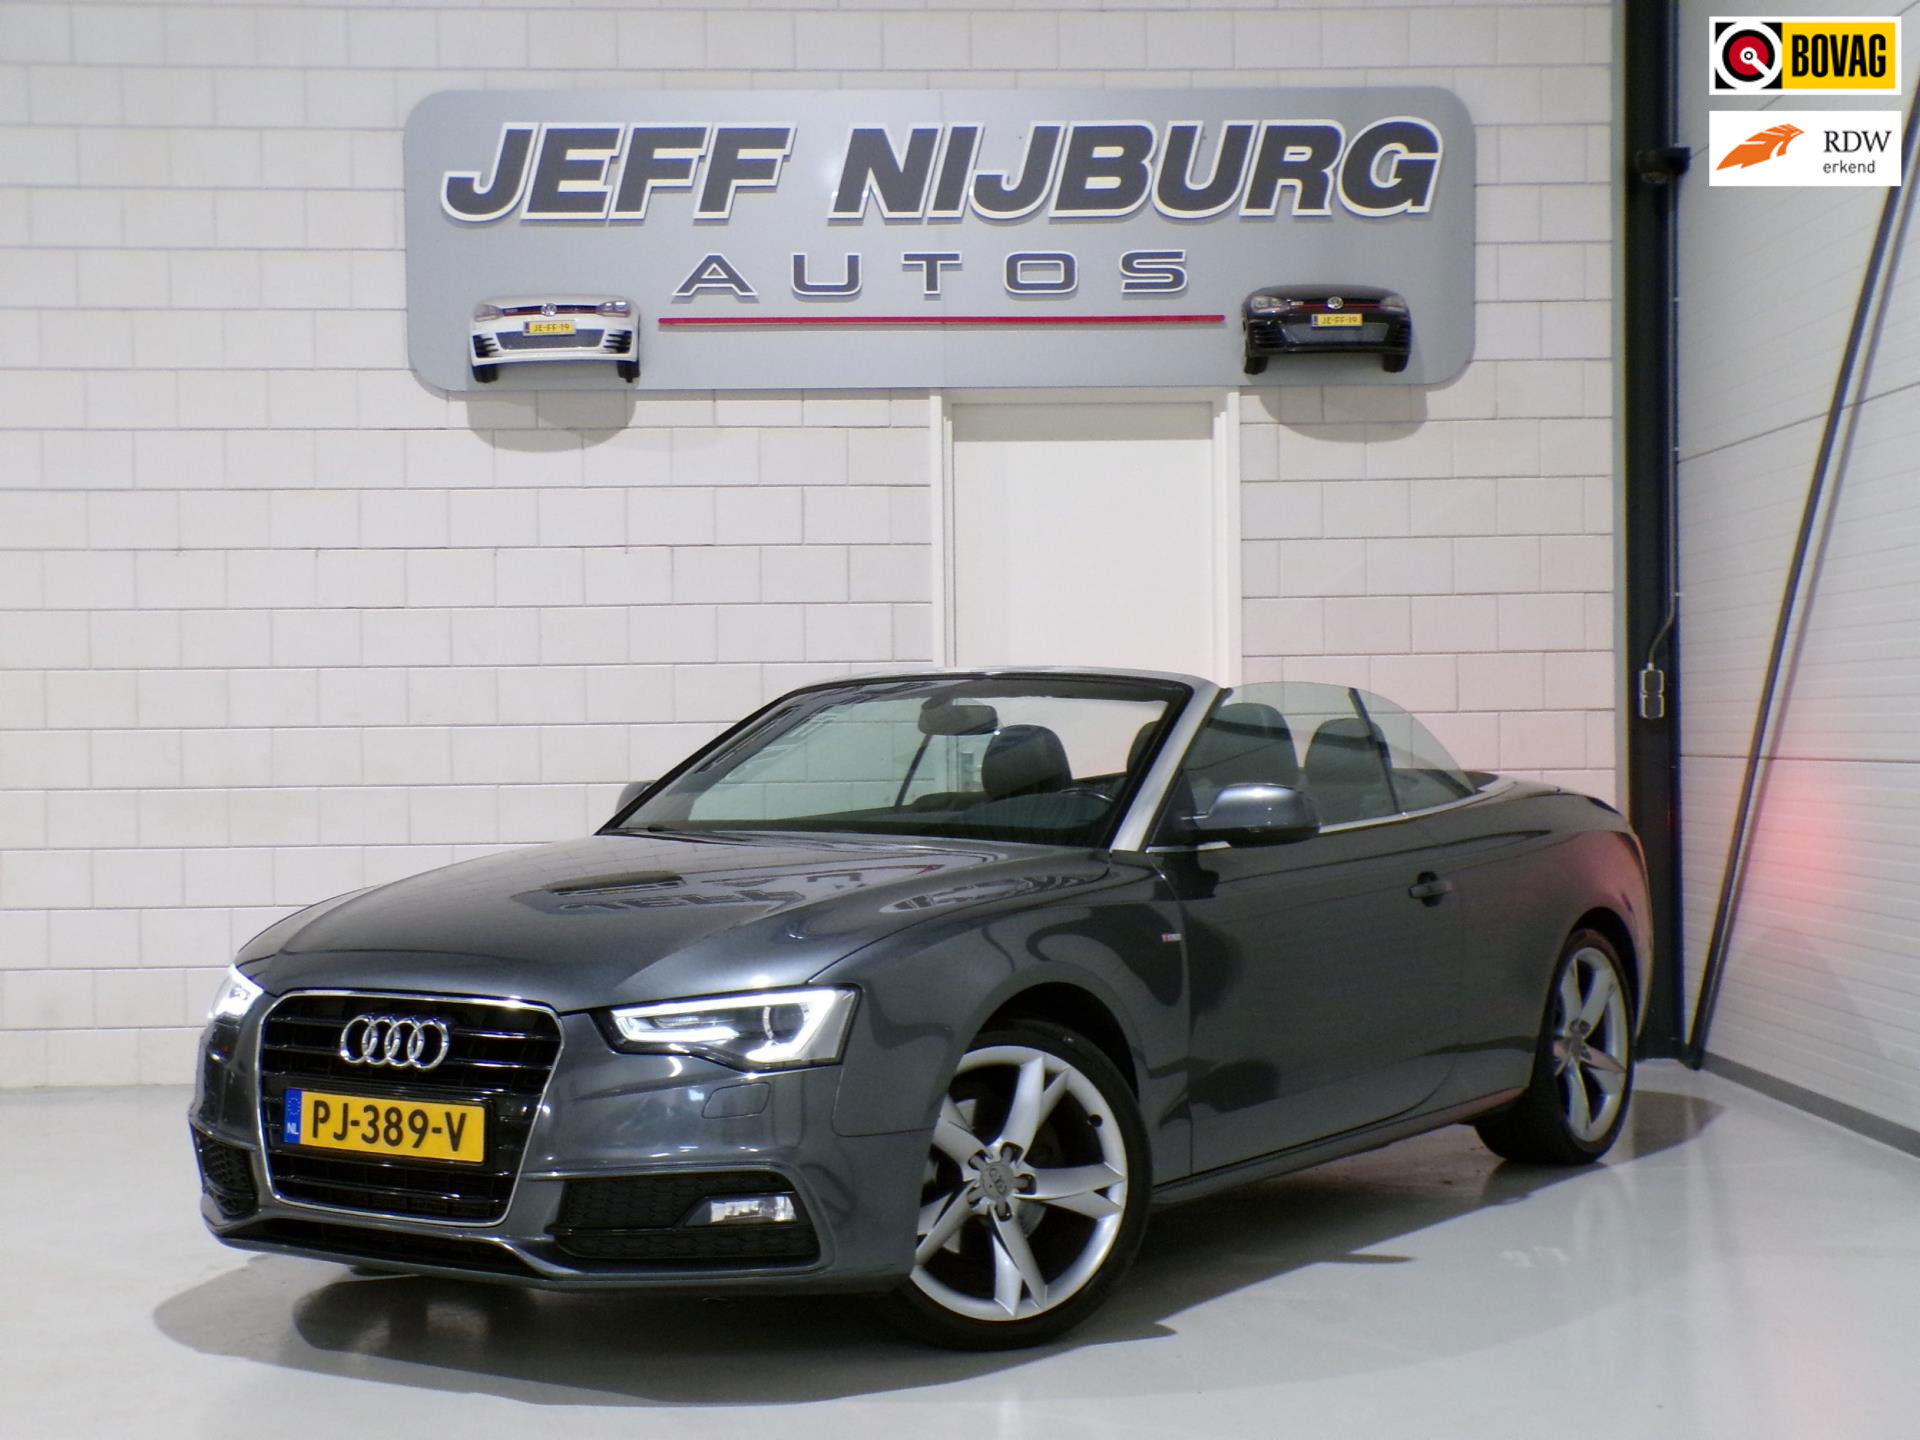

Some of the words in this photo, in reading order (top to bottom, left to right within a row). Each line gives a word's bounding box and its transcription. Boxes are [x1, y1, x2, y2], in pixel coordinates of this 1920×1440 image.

[441, 122, 797, 222] JEFF
[827, 116, 1443, 219] NIJBURG
[672, 249, 1188, 296] AUTOS
[286, 1124, 299, 1135] NL
[312, 1100, 467, 1152] PJ-389-V
